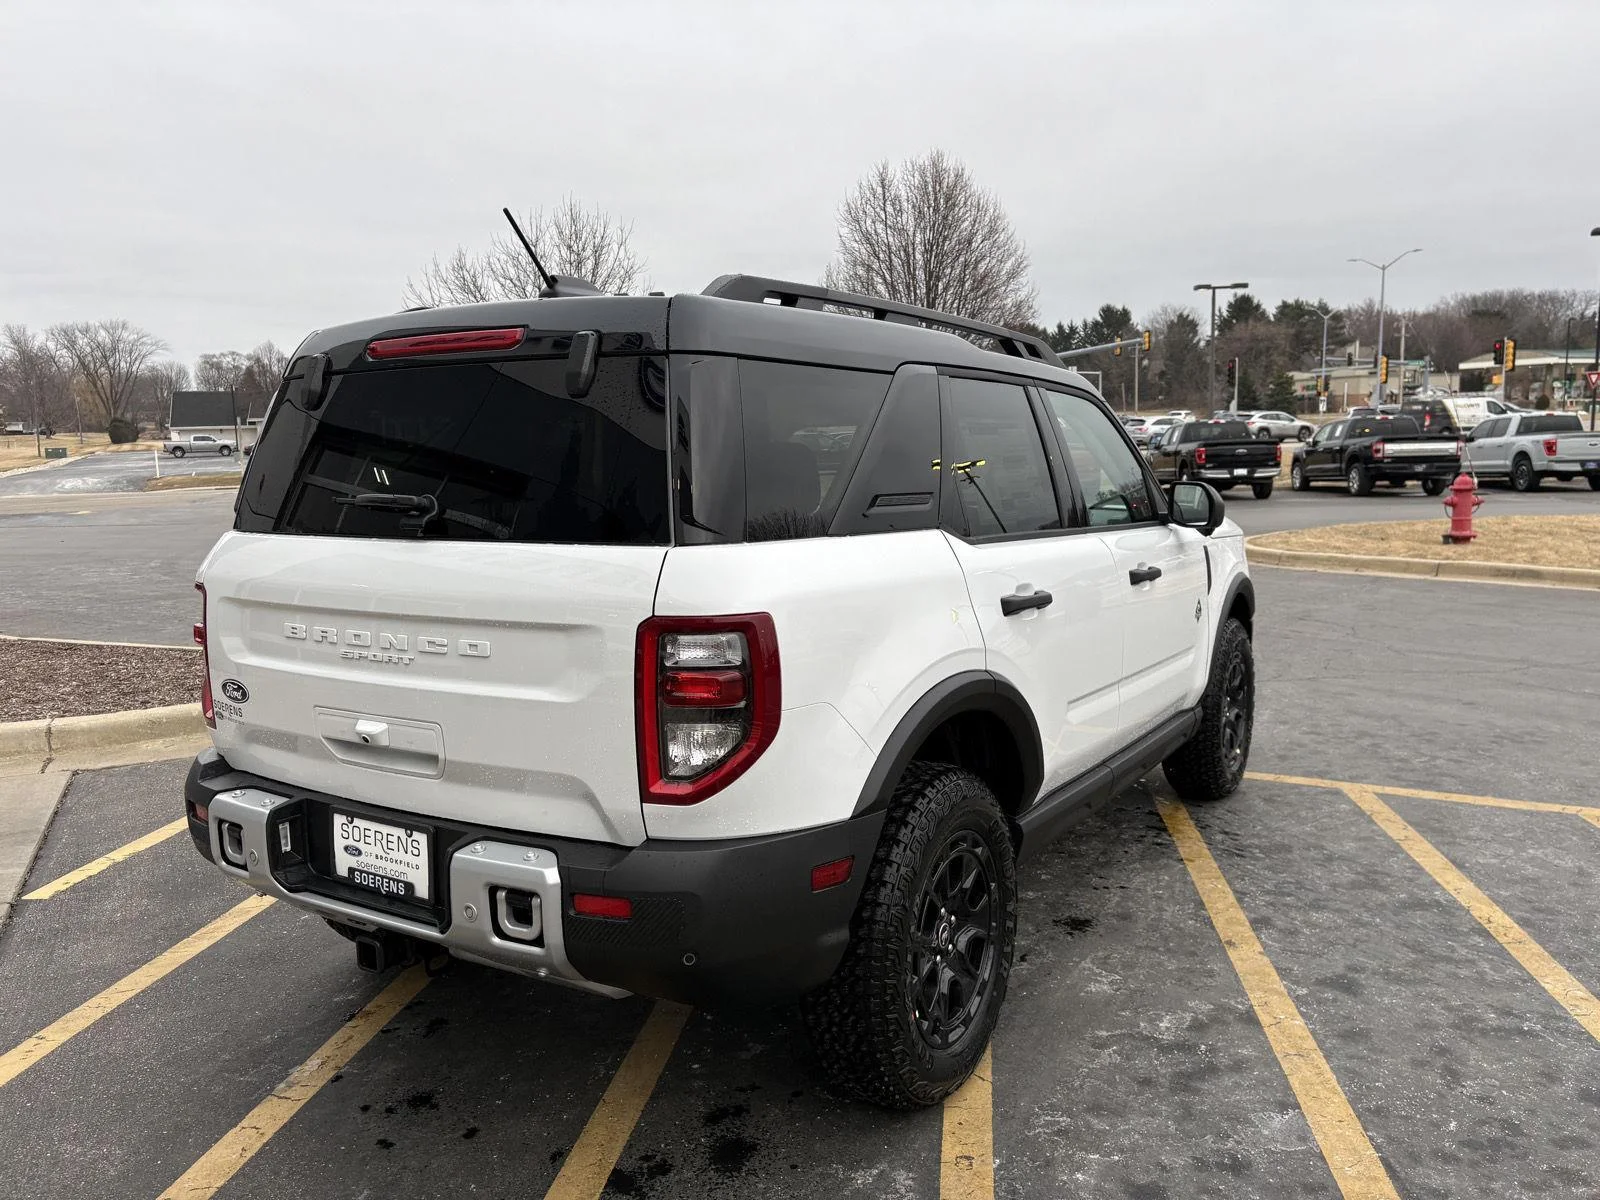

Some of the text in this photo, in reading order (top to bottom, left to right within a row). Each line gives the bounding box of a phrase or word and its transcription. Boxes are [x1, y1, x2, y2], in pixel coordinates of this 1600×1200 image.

[283, 622, 492, 658] BRONCO
[339, 648, 416, 665] SPORT
[225, 682, 245, 700] Ford
[214, 699, 243, 717] SOERENS
[341, 822, 420, 857] SOERENS
[356, 860, 408, 880] soerens.com
[375, 854, 420, 870] BROOKFIELD
[354, 871, 405, 895] SOERENS
